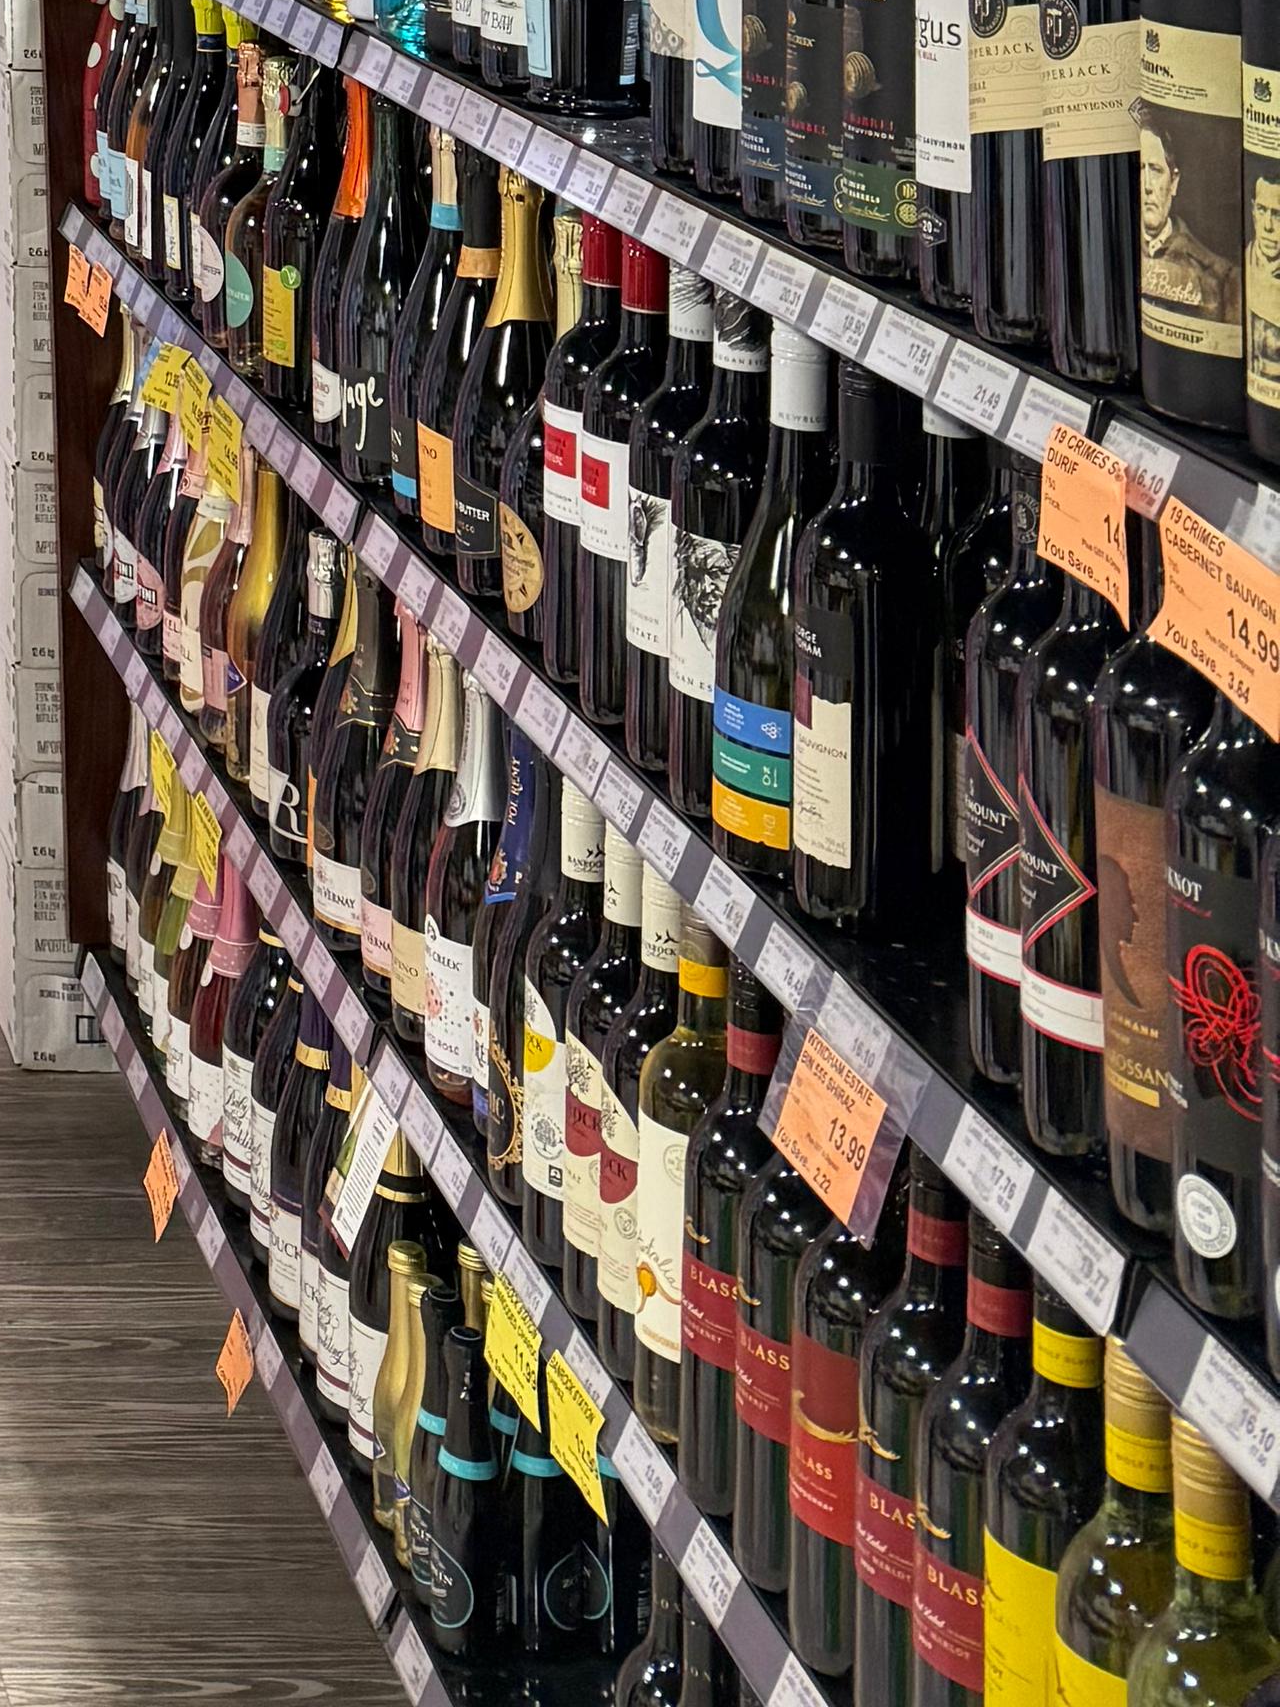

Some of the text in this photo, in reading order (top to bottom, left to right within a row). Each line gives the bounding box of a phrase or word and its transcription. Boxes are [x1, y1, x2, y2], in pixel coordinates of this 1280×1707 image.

[1047, 447, 1079, 475] DURIF
[1054, 427, 1111, 472] 19 CRIMES
[1169, 505, 1226, 557] 19 CRIMES
[1165, 527, 1224, 585] CABERNET
[1165, 619, 1189, 651] You
[1227, 608, 1280, 672] 14.99
[844, 1073, 874, 1106] ESTATE
[830, 1117, 867, 1171] 13.99
[740, 1330, 790, 1371] BLASS
